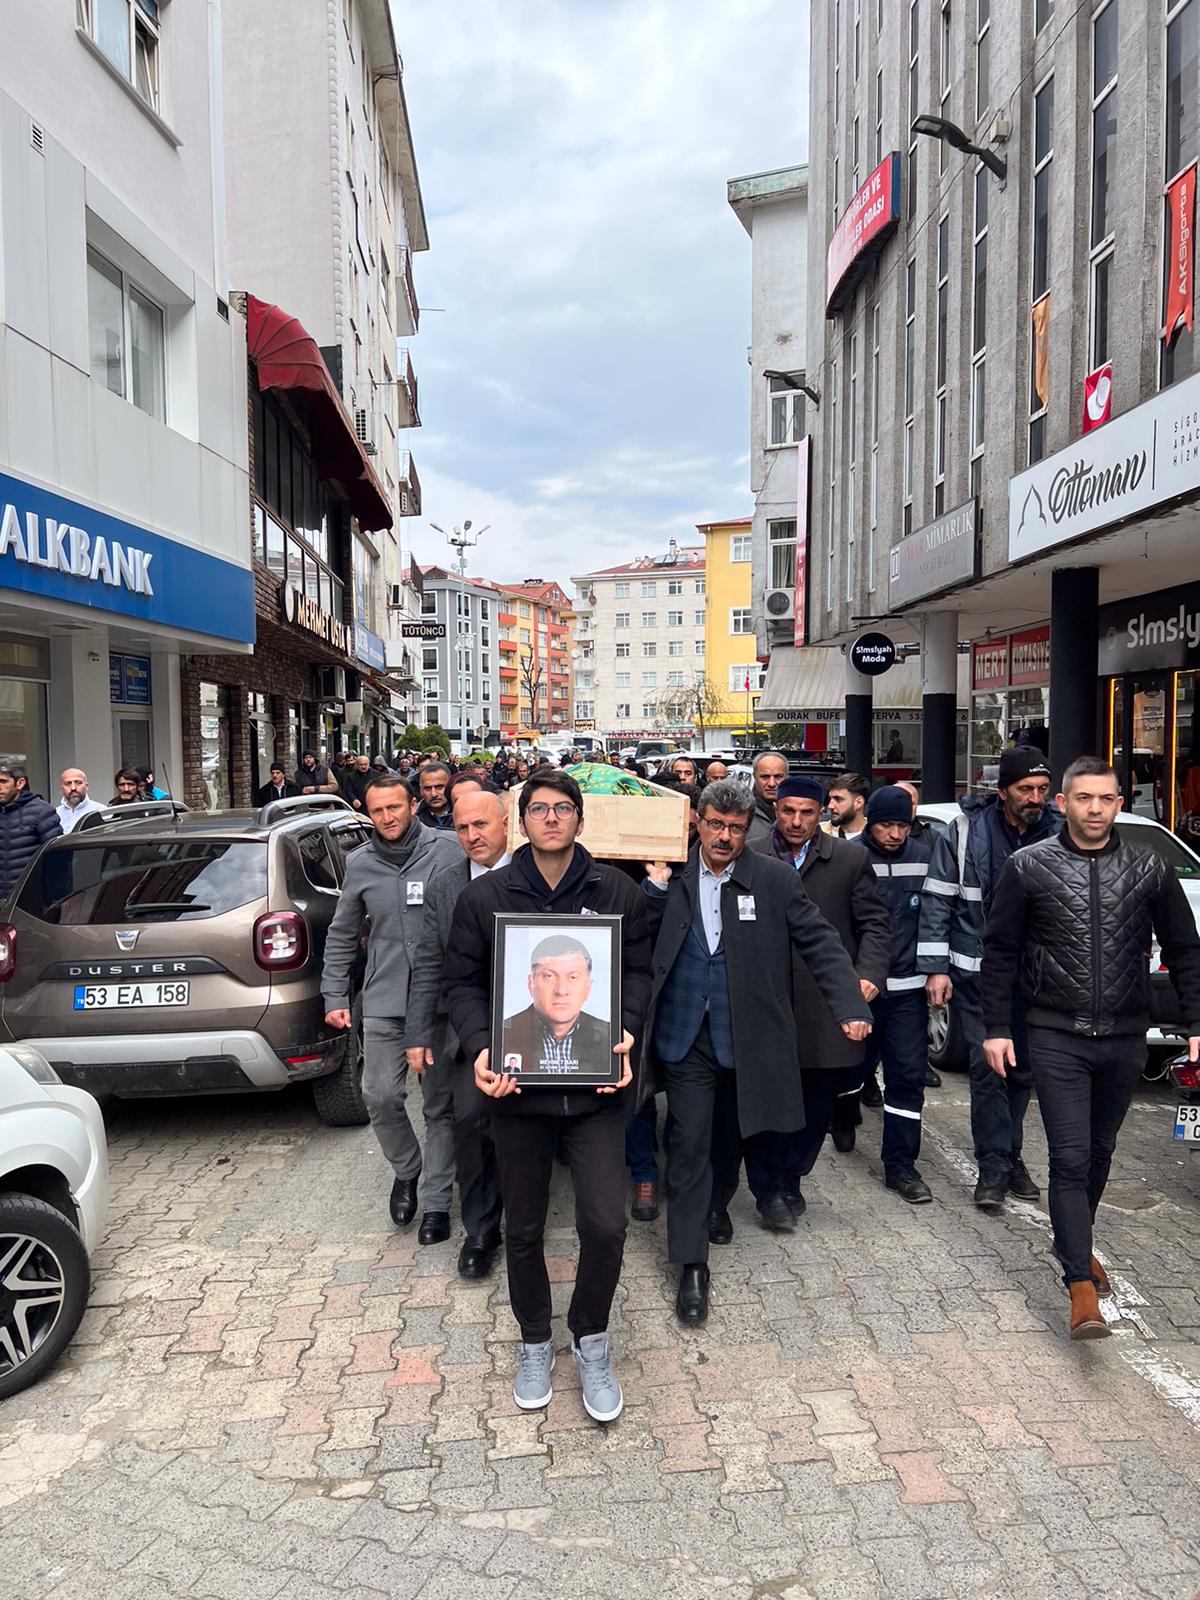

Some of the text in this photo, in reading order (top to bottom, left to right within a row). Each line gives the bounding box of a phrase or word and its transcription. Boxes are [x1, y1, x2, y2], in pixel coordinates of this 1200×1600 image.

[871, 172, 881, 194] VE
[1048, 450, 1147, 525] Ottoman
[0, 503, 154, 597] ALKBANK
[297, 592, 330, 642] MEHMET
[330, 615, 346, 651] USTA
[862, 655, 886, 663] Moda
[975, 649, 1007, 681] MERT
[777, 711, 809, 720] DURAK
[69, 963, 187, 976] DUSTER
[85, 986, 108, 1007] 53
[117, 984, 144, 1005] EA
[156, 982, 187, 1003] 158
[1179, 1107, 1198, 1122] 53
